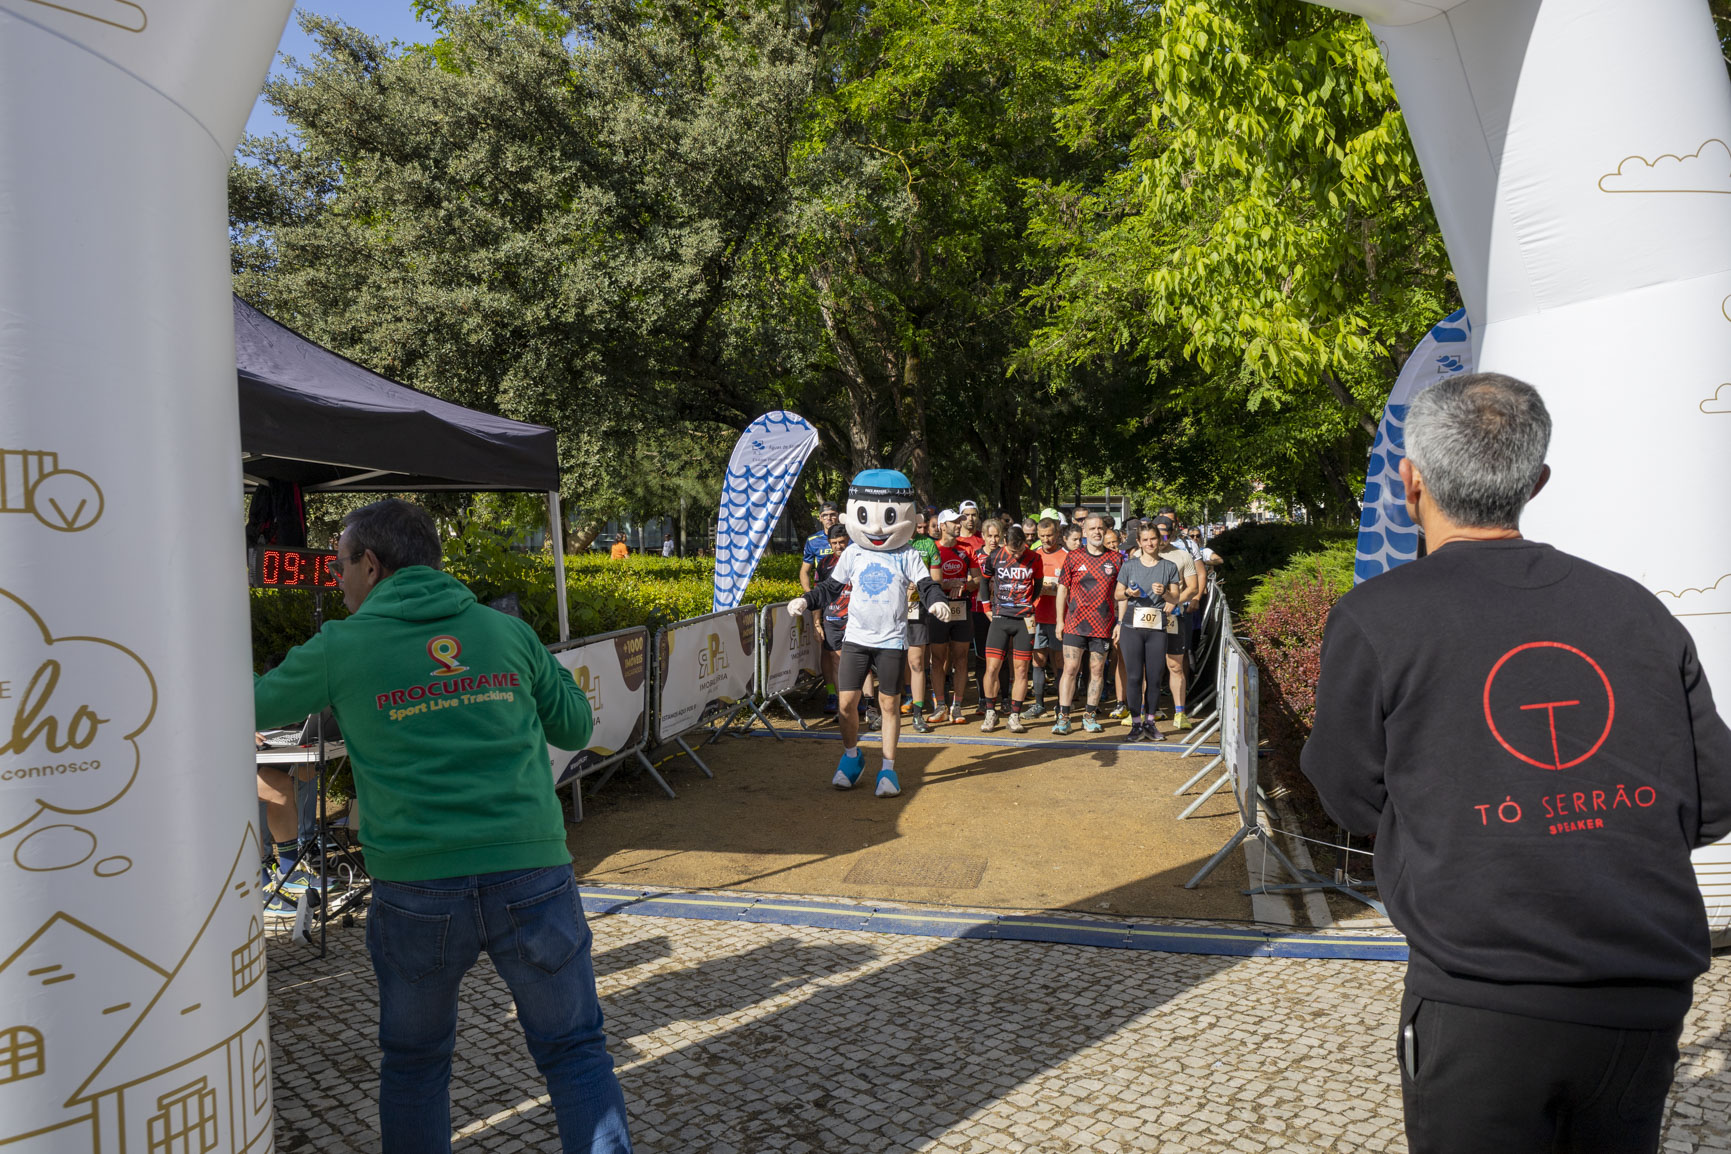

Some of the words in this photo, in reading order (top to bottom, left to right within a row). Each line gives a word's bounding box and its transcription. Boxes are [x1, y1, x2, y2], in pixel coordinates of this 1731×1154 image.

[1140, 613, 1157, 622] 207
[623, 636, 644, 655] +1000
[376, 673, 521, 711] PROCURAME
[389, 703, 428, 721] Sport
[430, 697, 461, 712] Live
[462, 690, 514, 706] Tracking
[1, 760, 101, 781] connosco
[1474, 795, 1522, 826] TÓ
[1542, 784, 1656, 818] SERRÃO
[1549, 818, 1604, 835] SPEAKER
